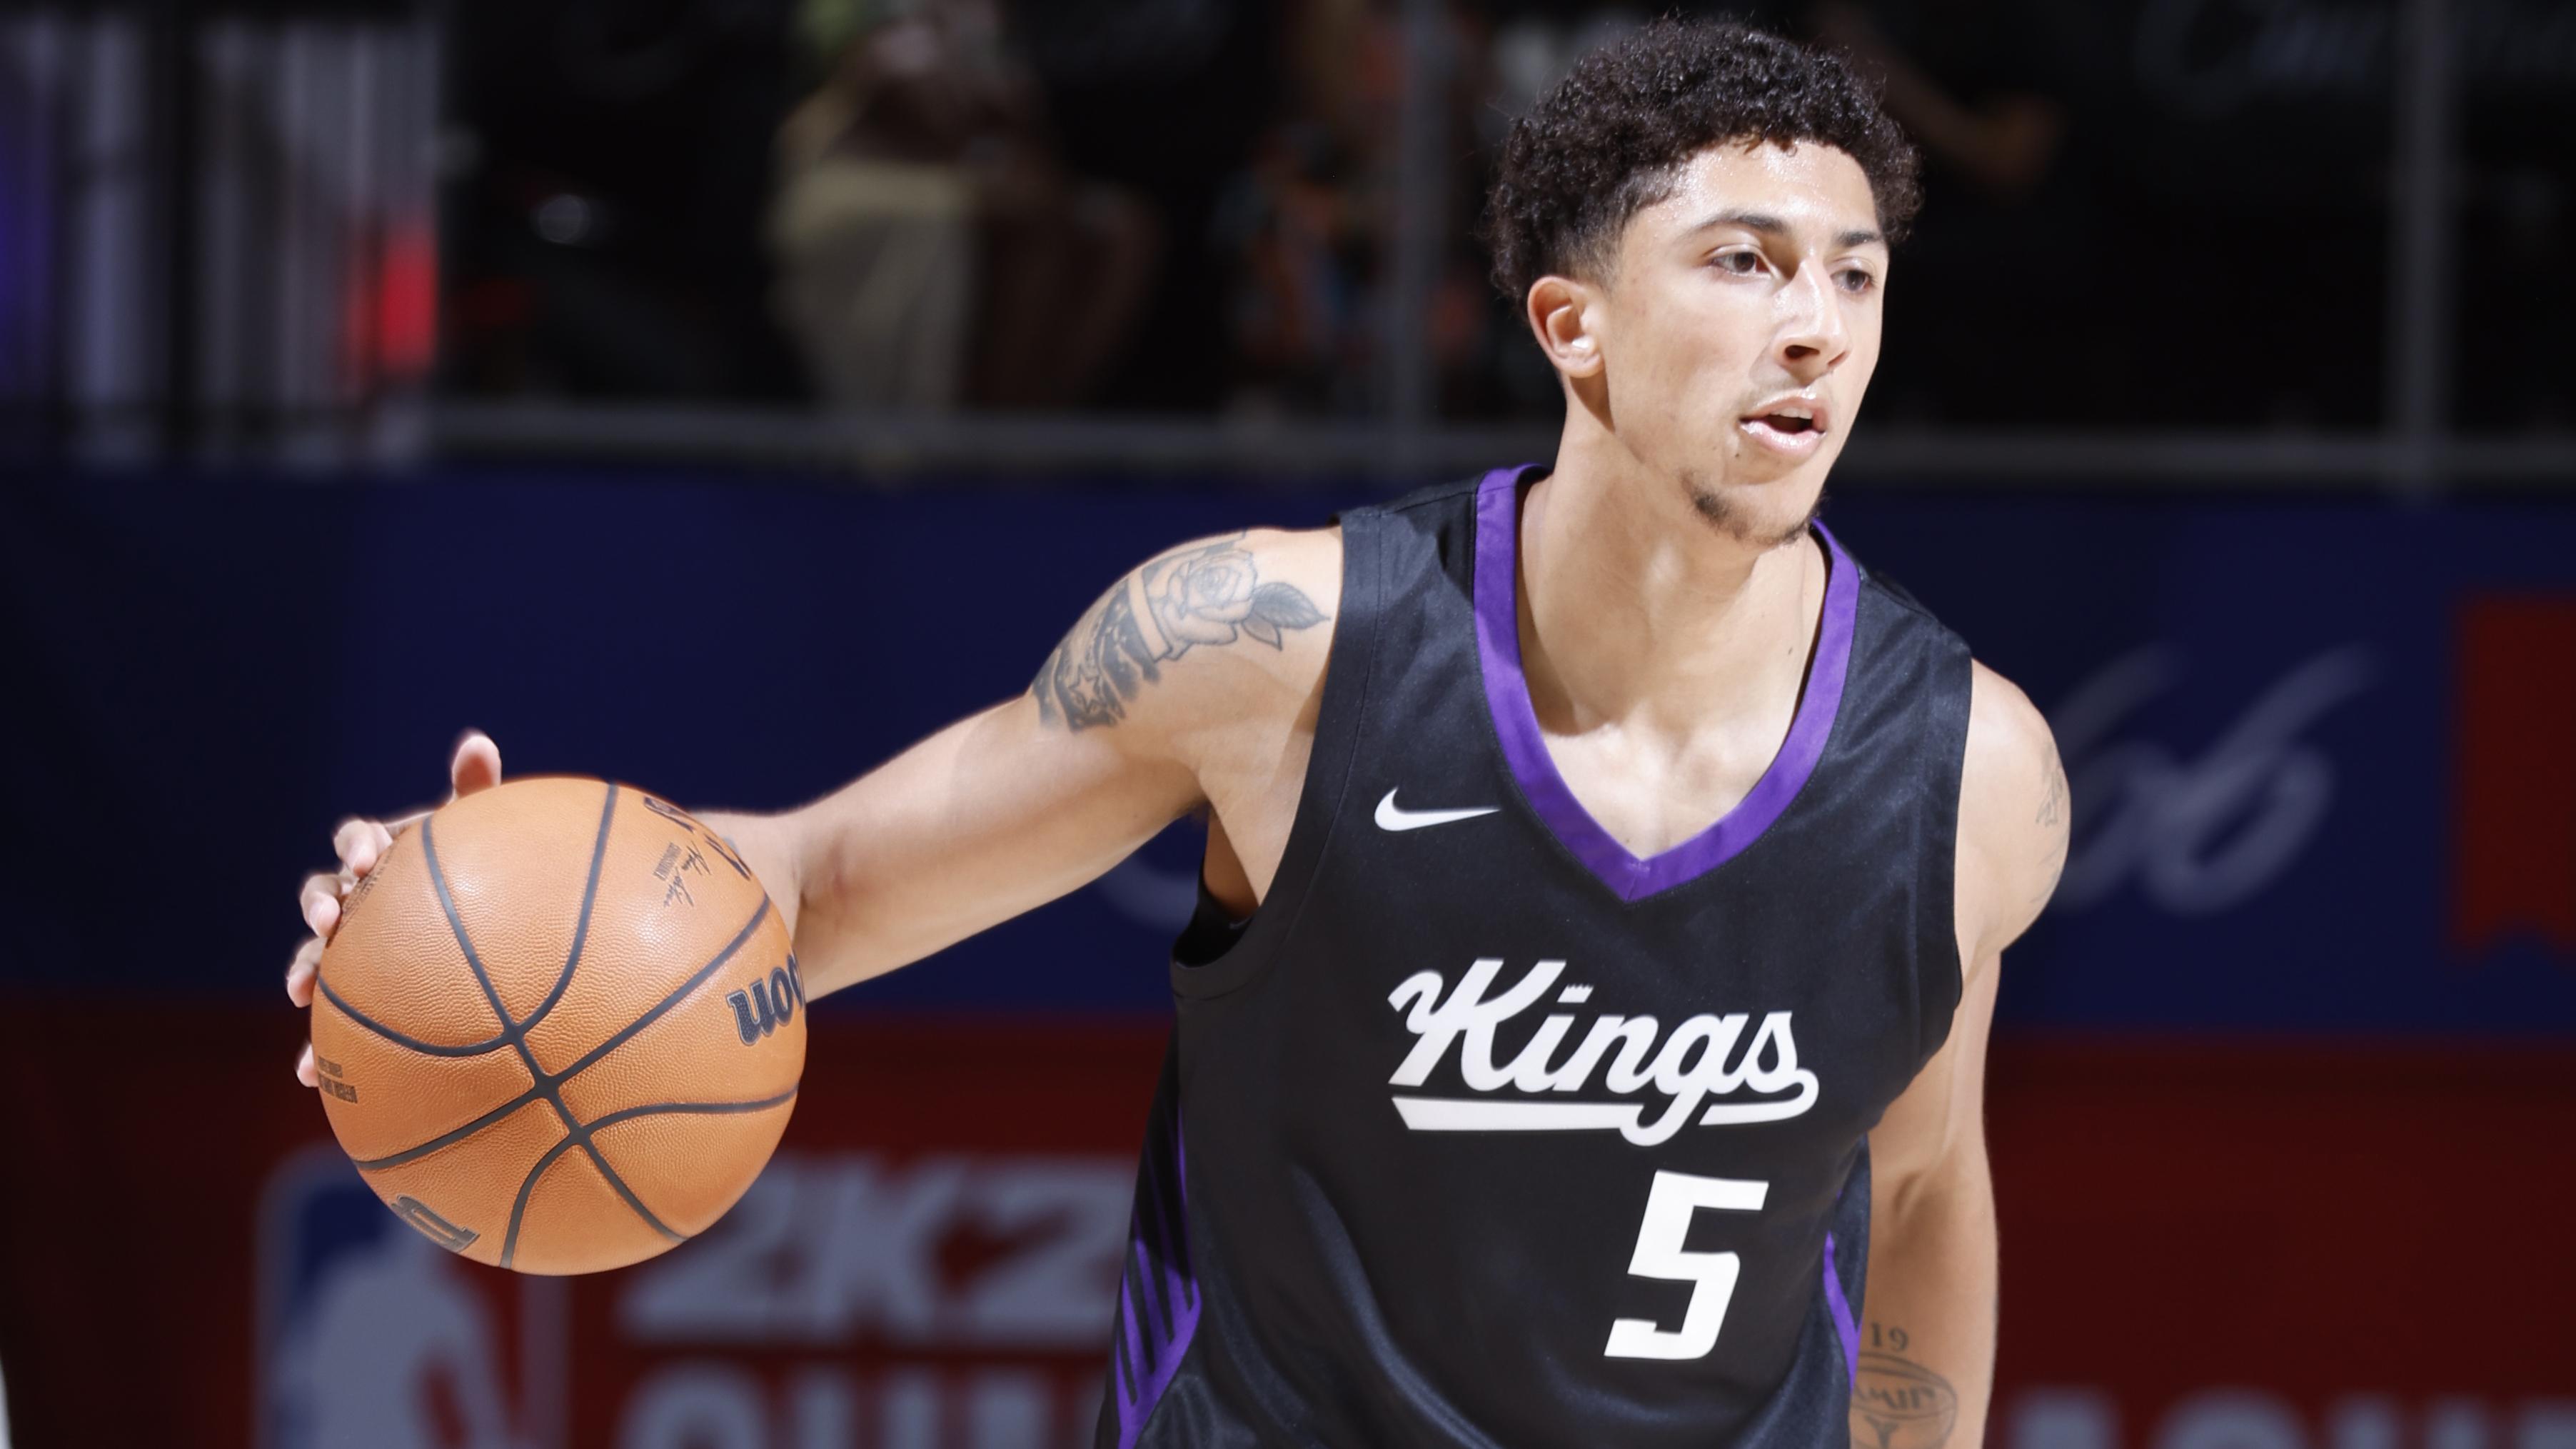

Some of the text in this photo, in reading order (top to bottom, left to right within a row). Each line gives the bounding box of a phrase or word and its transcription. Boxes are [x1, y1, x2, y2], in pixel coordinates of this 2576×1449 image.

[1387, 958, 1819, 1146] Kings
[1604, 1169, 1769, 1360] 5
[1871, 1321, 1910, 1352] 19
